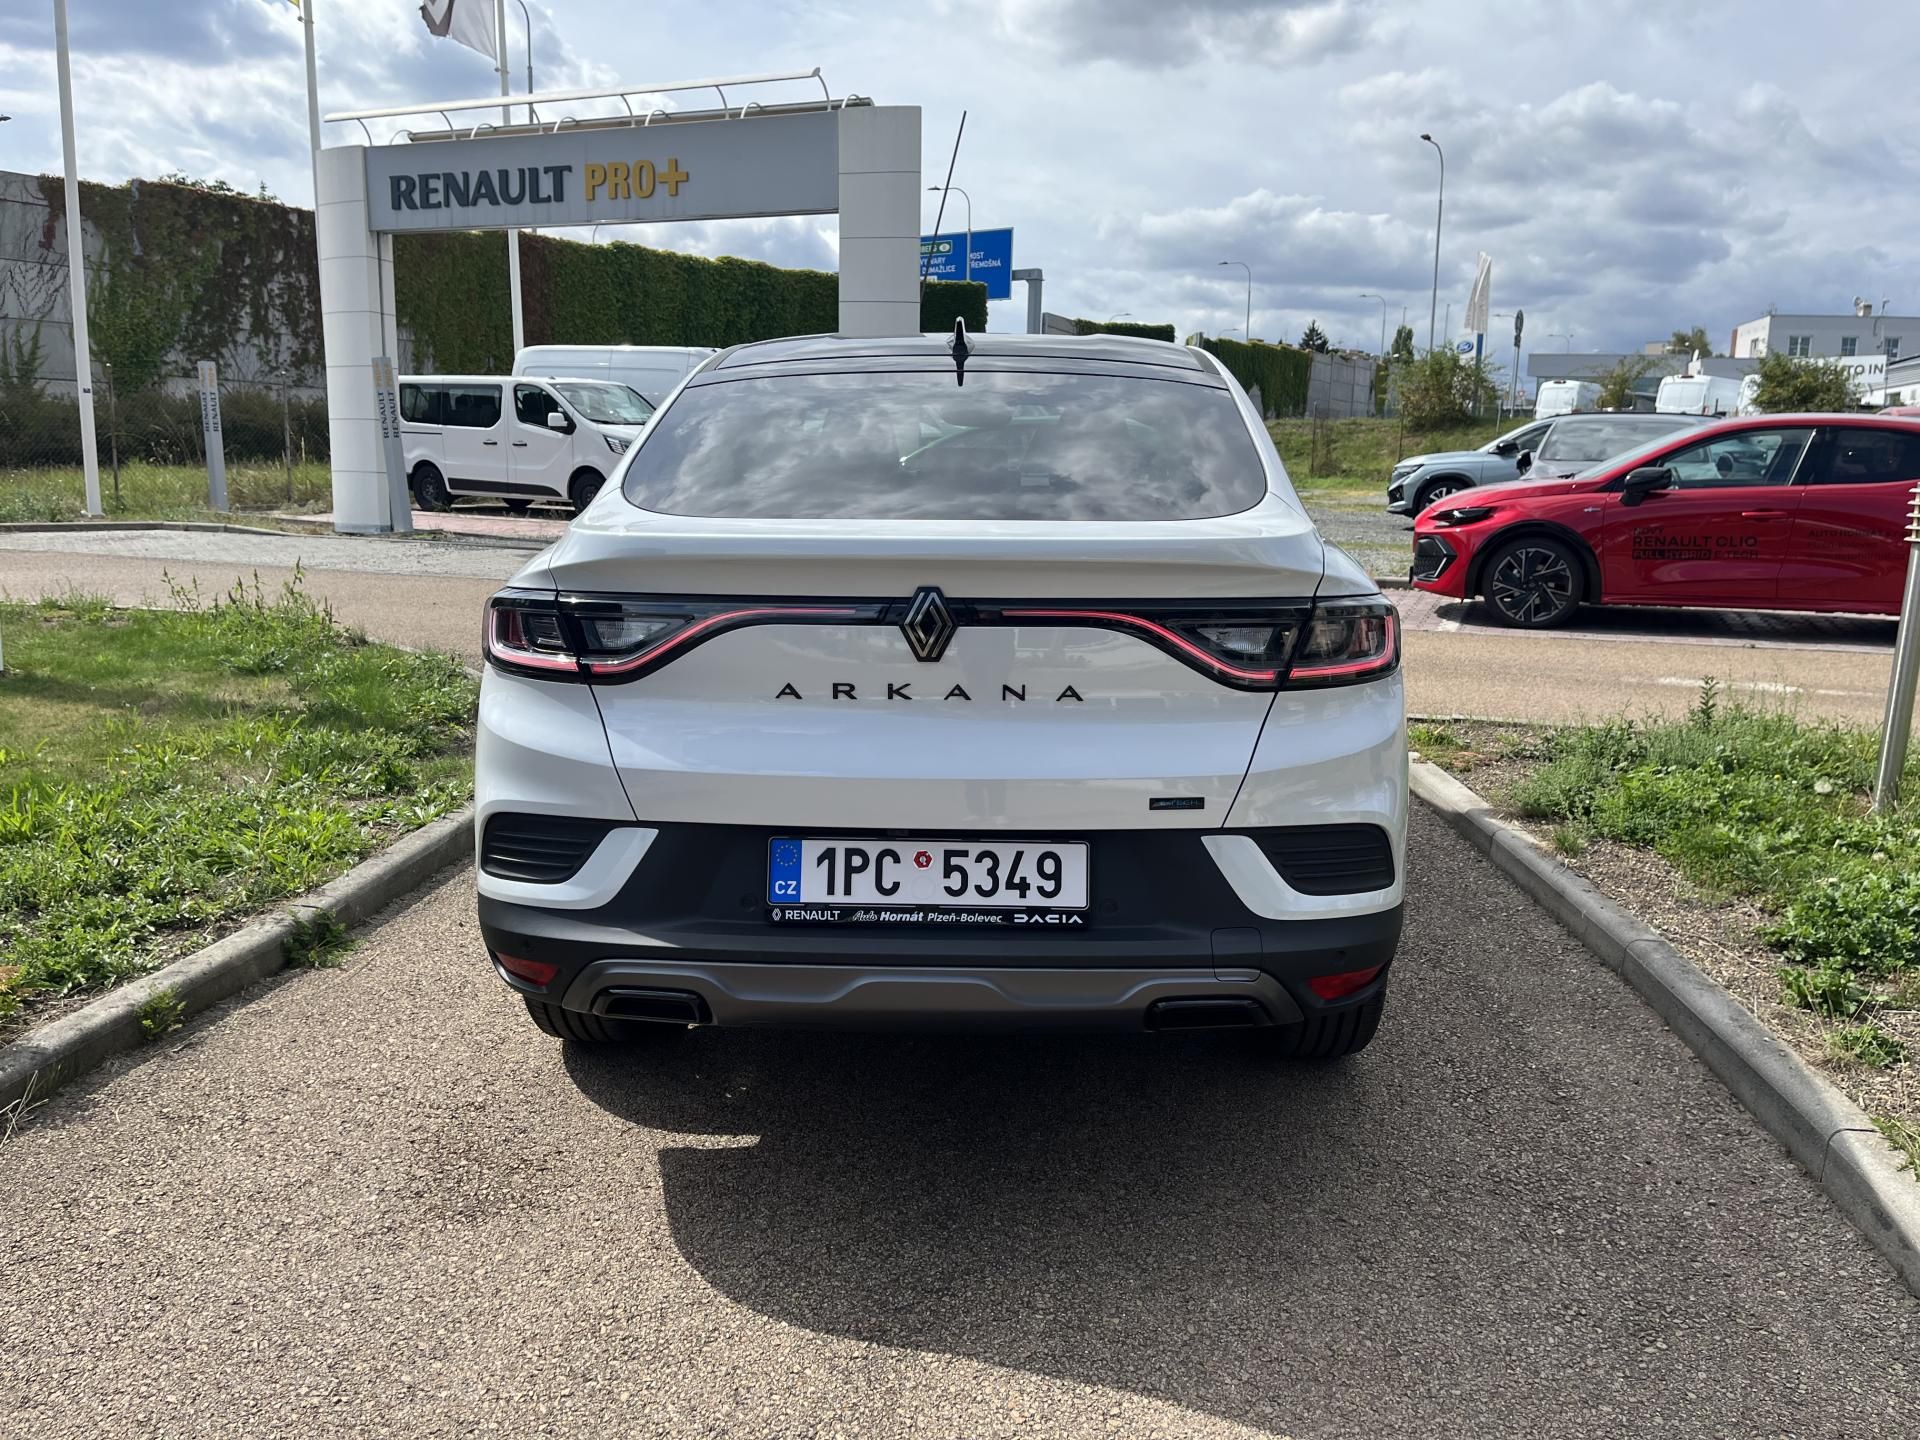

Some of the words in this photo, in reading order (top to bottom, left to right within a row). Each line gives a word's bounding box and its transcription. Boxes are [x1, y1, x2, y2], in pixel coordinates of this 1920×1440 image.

[390, 165, 572, 210] RENAULT
[584, 158, 688, 200] PRO+
[970, 259, 1001, 268] ŘEMOŠNÁ
[1869, 363, 1884, 374] IN
[210, 392, 220, 432] RENAULT
[378, 391, 389, 438] RENAULT
[388, 391, 400, 438] RENAULT
[1632, 536, 1712, 547] RENAULT
[1715, 536, 1758, 548] CLIO
[775, 682, 1084, 702] ARKANA
[816, 847, 901, 896] 1PC
[943, 850, 1063, 899] 5349
[775, 880, 797, 895] CZ
[785, 910, 841, 921] RENAULT
[879, 911, 925, 922] Hornát
[927, 912, 1002, 923] Plzeň-Bolevec
[1013, 913, 1084, 924] DACIA
